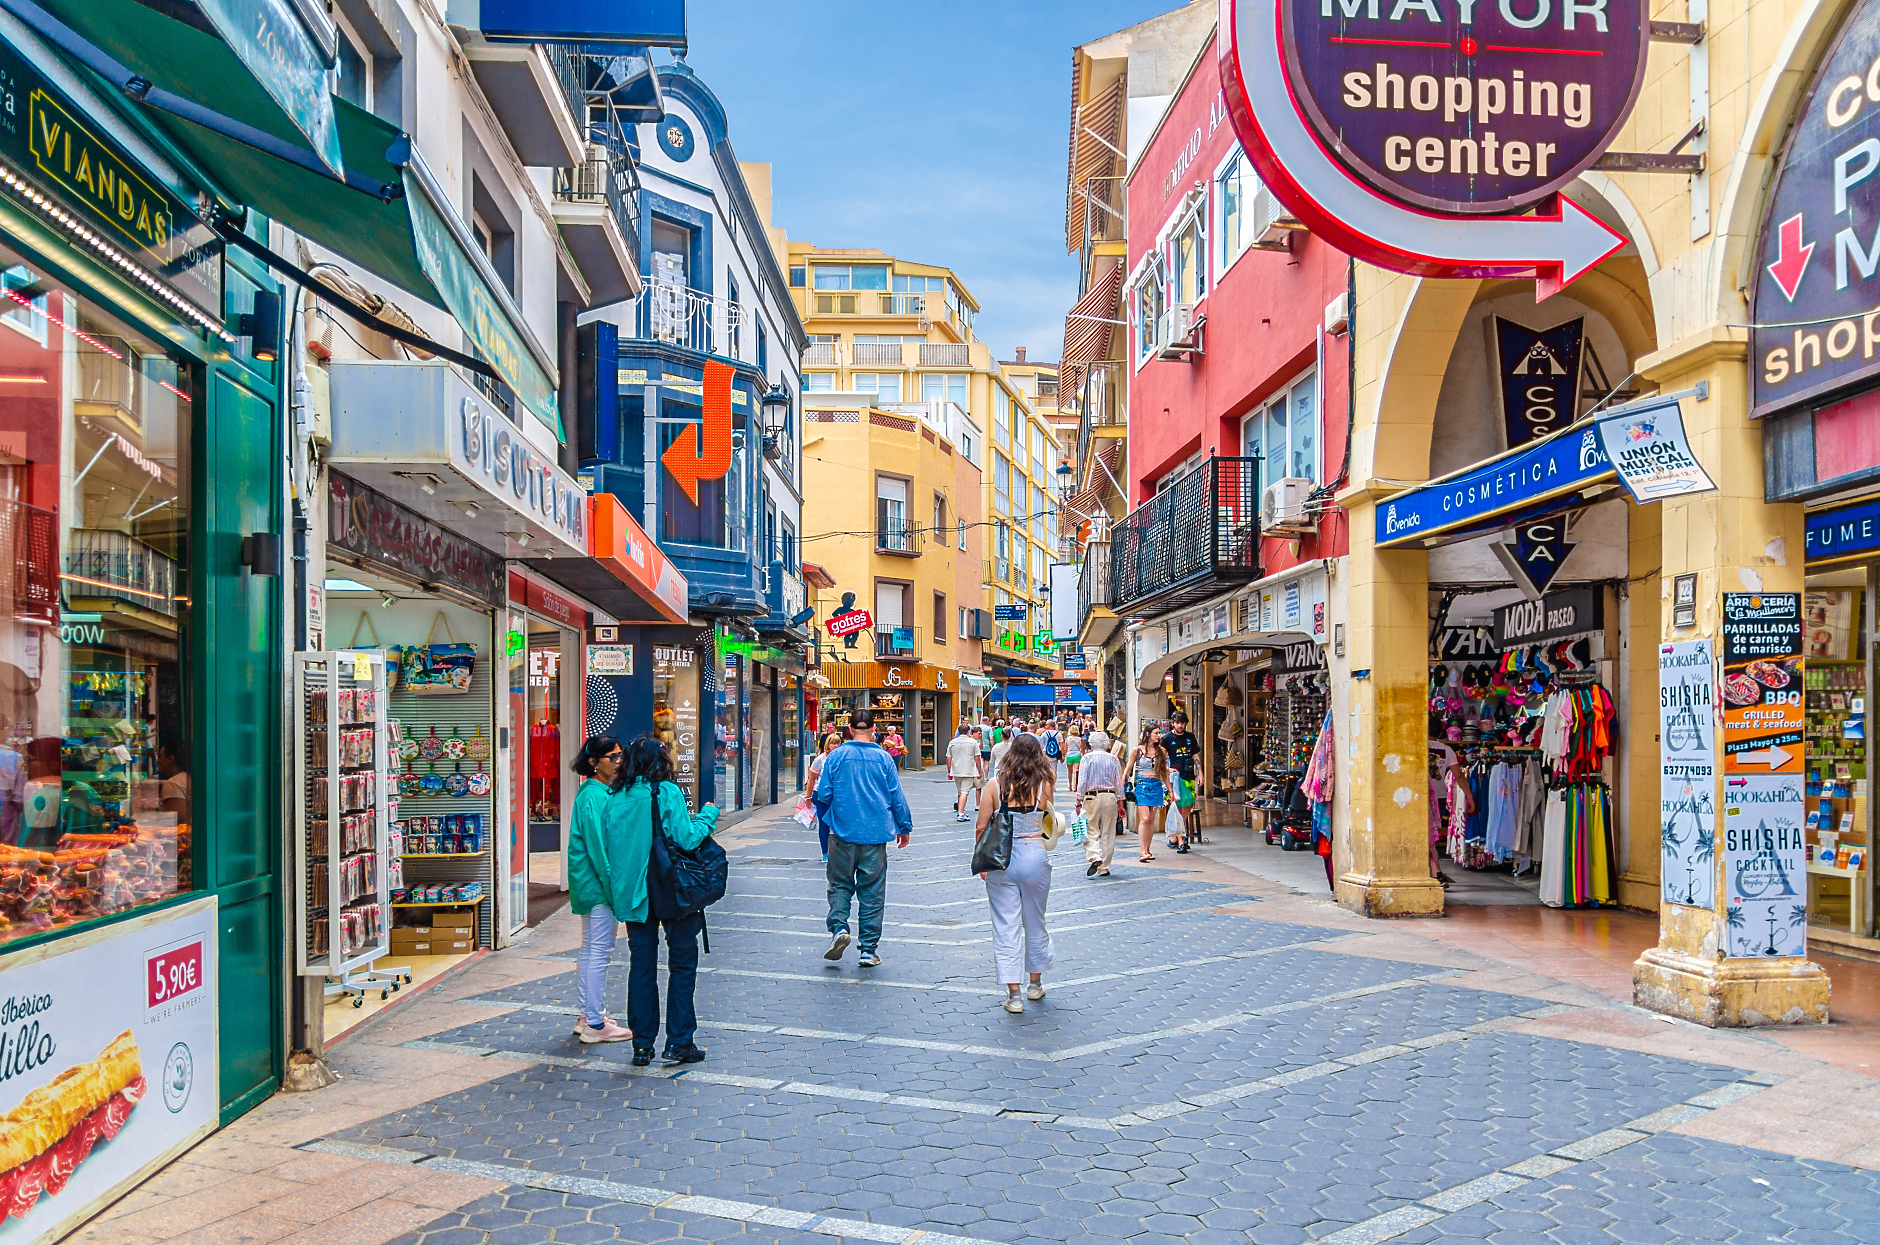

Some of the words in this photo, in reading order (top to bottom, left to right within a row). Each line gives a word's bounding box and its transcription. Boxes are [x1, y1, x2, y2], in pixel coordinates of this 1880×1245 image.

[1343, 63, 1591, 128] shopping
[1164, 127, 1201, 203] EDIFICIO
[1385, 132, 1556, 177] center
[39, 109, 166, 249] VIANDAS
[477, 306, 518, 382] VIANDAS
[1618, 452, 1689, 472] MUSICAL
[1620, 441, 1677, 461] UNIÓN
[461, 397, 583, 542] BISUTERIA
[1443, 458, 1557, 511] COSMÉTICA
[370, 505, 442, 572] REGALOS
[831, 612, 867, 634] gofres
[1504, 600, 1545, 639] MODA
[1548, 606, 1575, 630] PASEO
[1724, 623, 1800, 634] PARRILLADAS
[1733, 633, 1747, 644] de
[1749, 635, 1780, 644] carne
[1782, 635, 1789, 645] y
[1733, 643, 1747, 654] de
[1749, 643, 1793, 654] marisco
[655, 647, 694, 662] OUTLET
[1661, 683, 1711, 707] SHISHA
[1765, 690, 1801, 707] BBQ
[1666, 713, 1706, 726] COCKTAIL
[1725, 720, 1751, 729] meat
[1753, 720, 1761, 728] &
[1763, 719, 1802, 728] seafood
[1743, 710, 1785, 720] GRILLED
[1727, 743, 1748, 752] Plaza
[1749, 739, 1774, 748] Mayor
[1663, 765, 1713, 776] 637774093
[1727, 827, 1803, 851] SHISHA
[1736, 858, 1795, 872] COCKTAIL
[155, 959, 197, 1001] 5,90€
[1, 993, 53, 1027] Ibérico
[150, 1008, 172, 1025] WE'RE
[173, 995, 202, 1015] FARMERS
